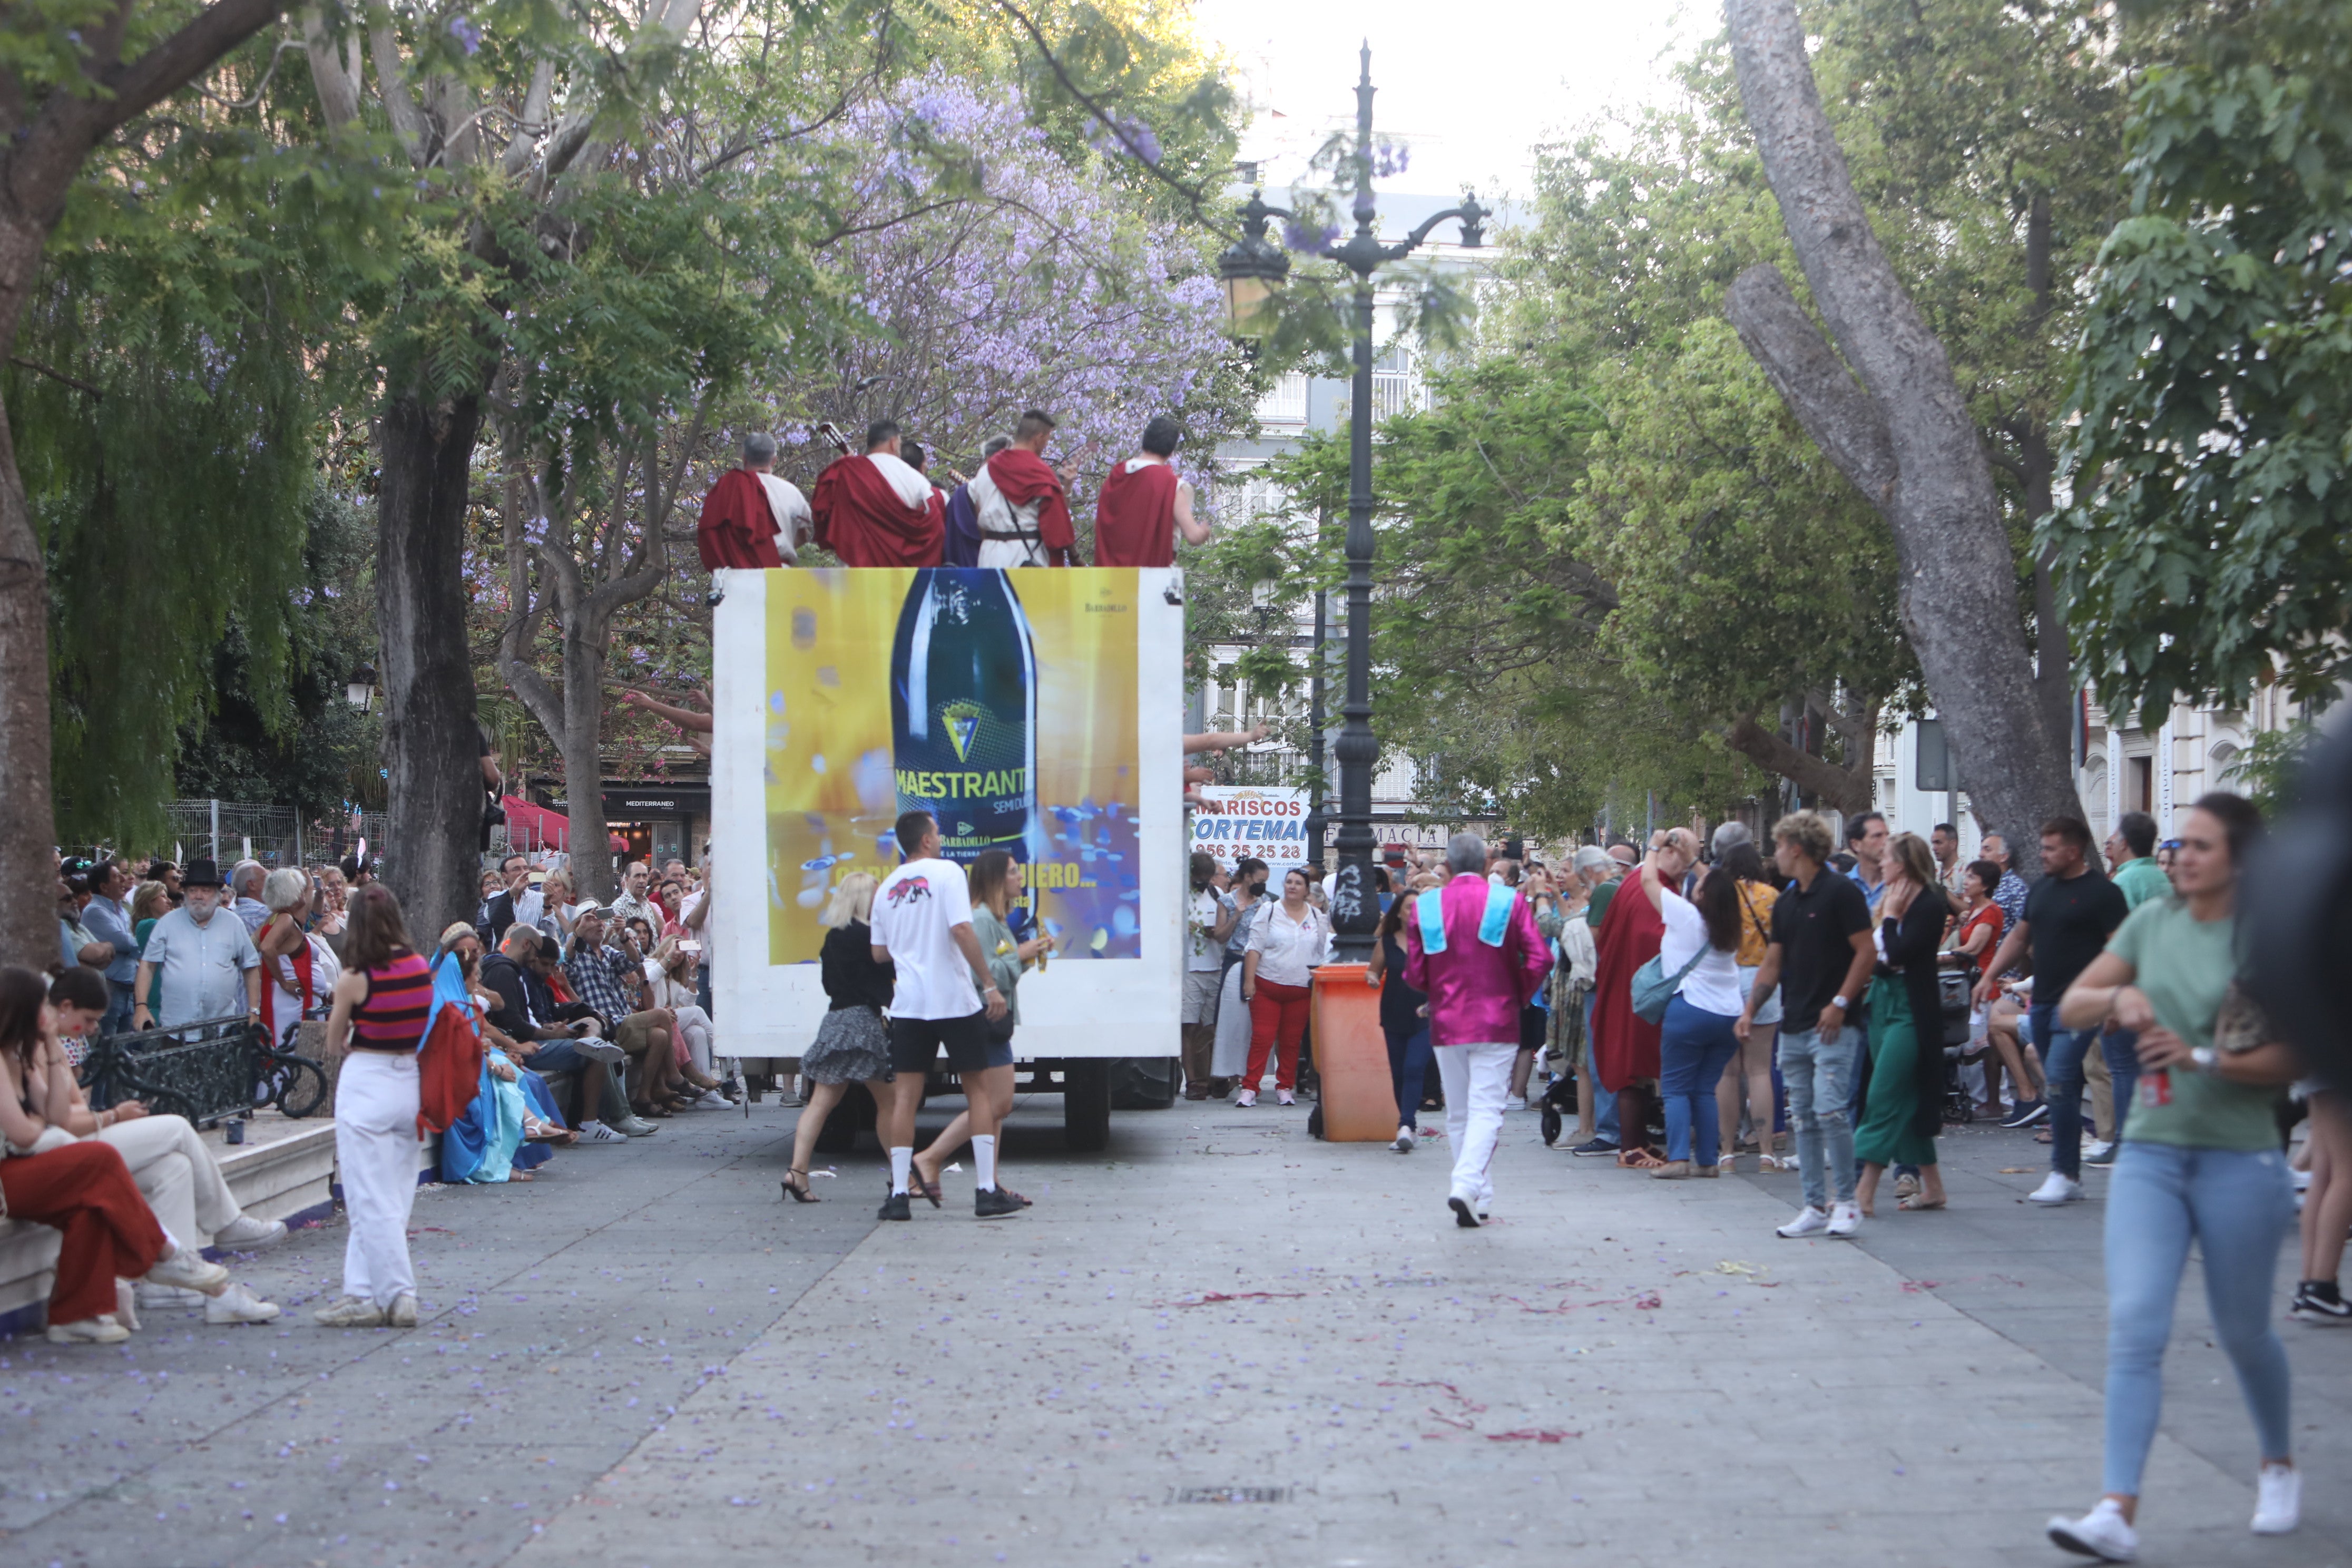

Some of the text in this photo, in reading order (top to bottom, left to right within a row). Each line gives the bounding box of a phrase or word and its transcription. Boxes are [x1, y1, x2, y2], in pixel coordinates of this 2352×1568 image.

[895, 767, 1025, 799] MAESTRANT
[993, 799, 1014, 815] SEMI
[939, 835, 991, 848] BARBADILLO
[1325, 828, 1436, 842] FMACIA
[1196, 844, 1301, 859] 956 25 25 28
